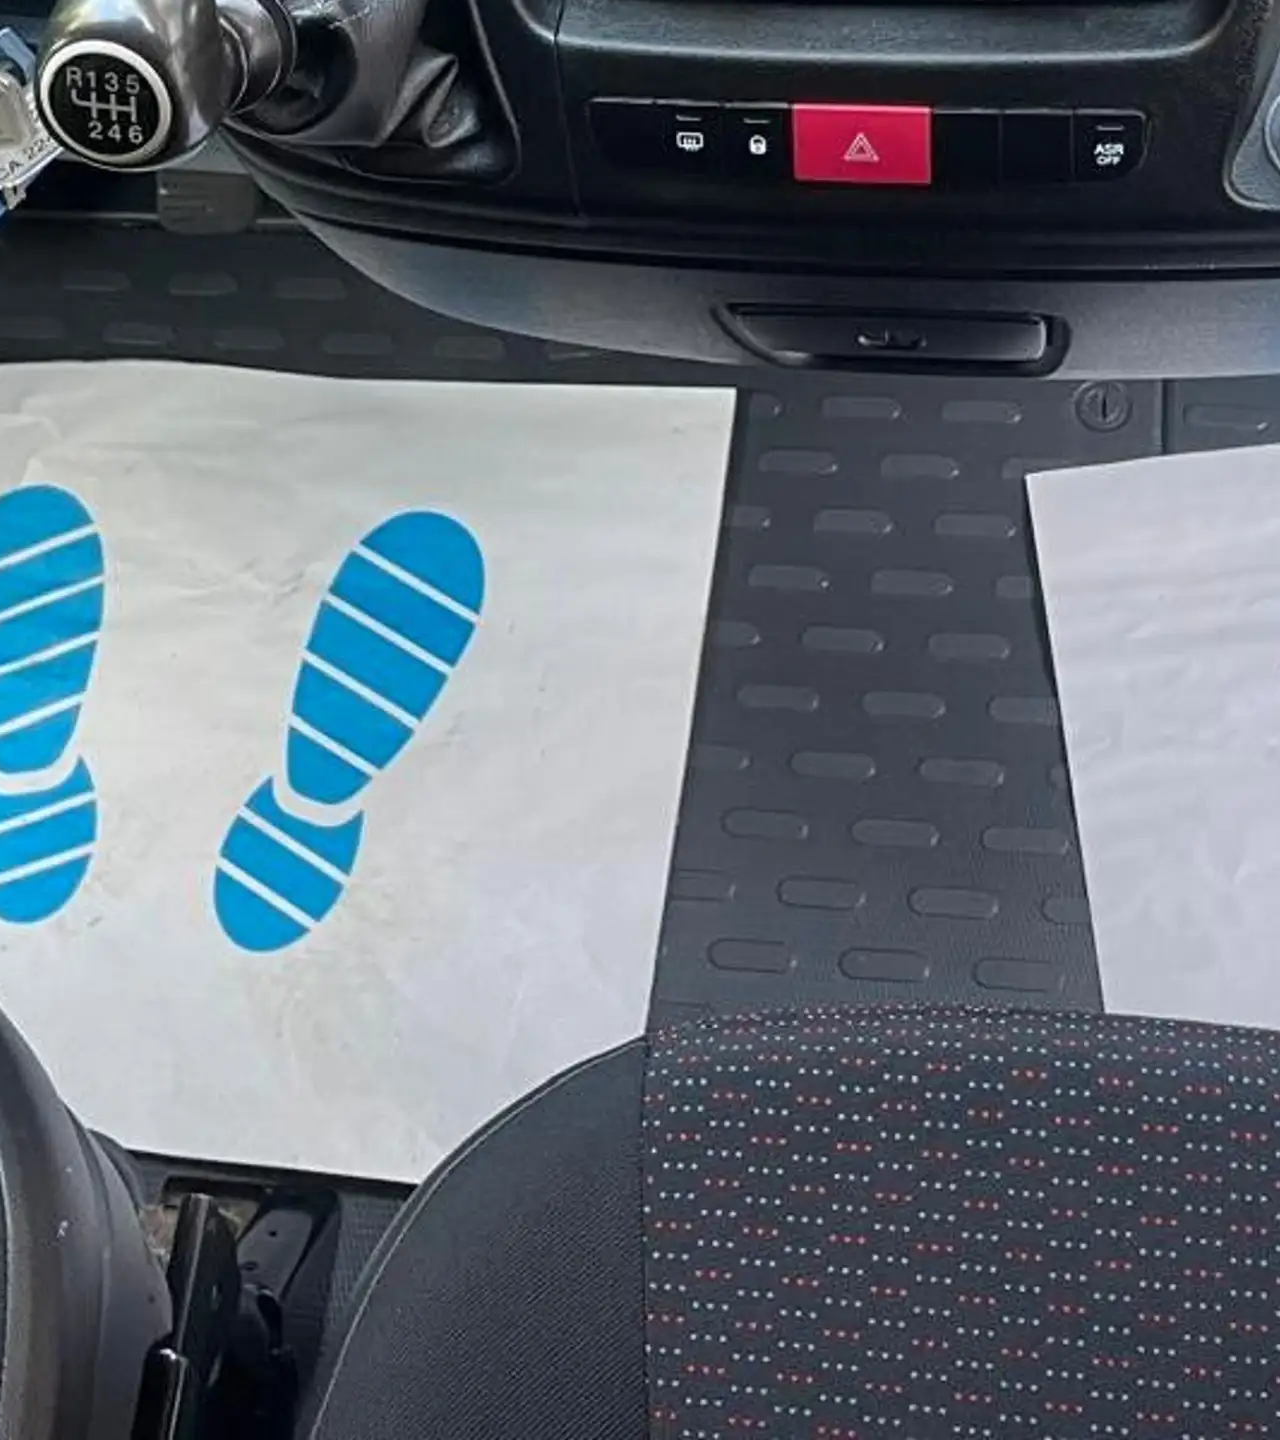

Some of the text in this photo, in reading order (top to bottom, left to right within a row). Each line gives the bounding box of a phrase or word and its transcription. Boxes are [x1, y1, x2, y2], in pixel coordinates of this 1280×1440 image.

[66, 66, 140, 95] R 1 3 5
[88, 120, 144, 145] 2 4 6
[1094, 143, 1124, 155] ASR
[1096, 155, 1121, 166] OFF
